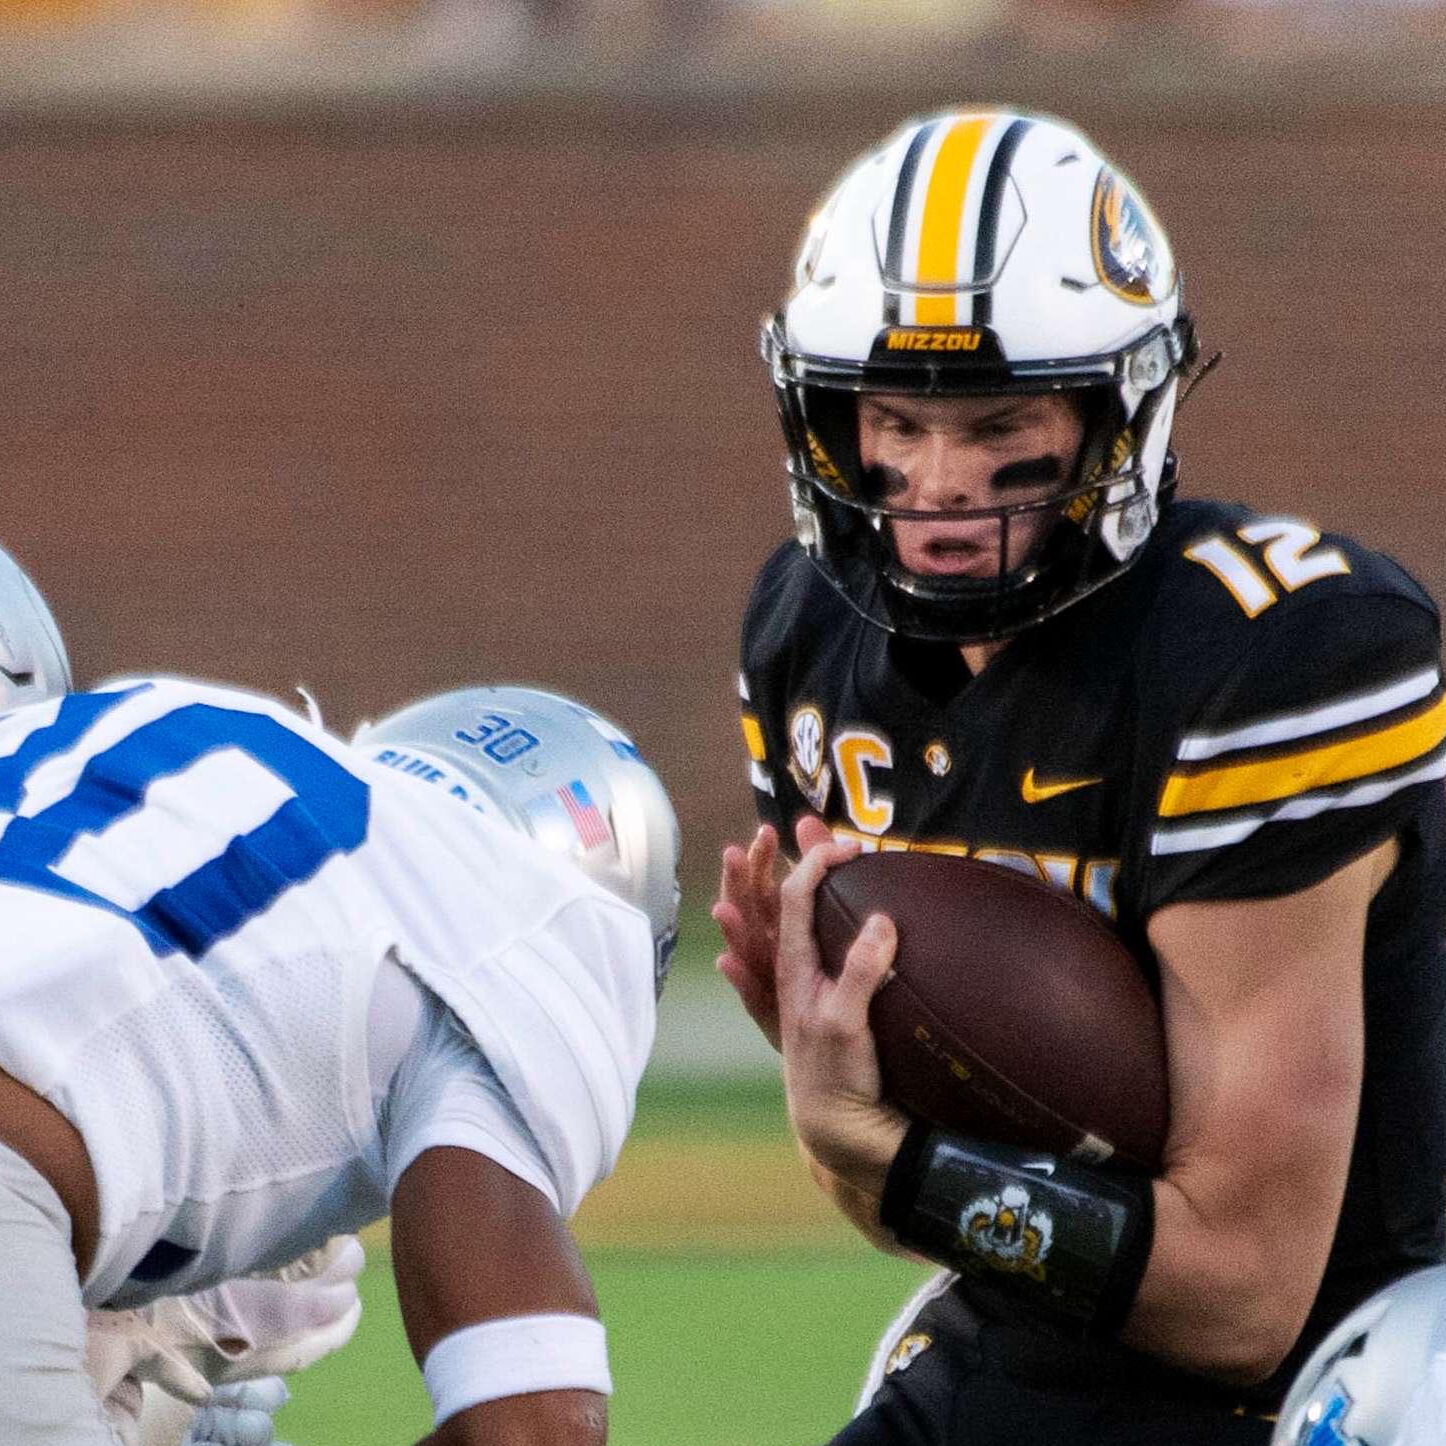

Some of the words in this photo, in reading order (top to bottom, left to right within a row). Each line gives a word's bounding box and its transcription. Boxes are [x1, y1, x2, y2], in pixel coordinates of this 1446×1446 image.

[887, 330, 983, 352] MIZZOU
[1182, 514, 1352, 619] 12
[453, 713, 542, 766] 30
[831, 731, 895, 836] C
